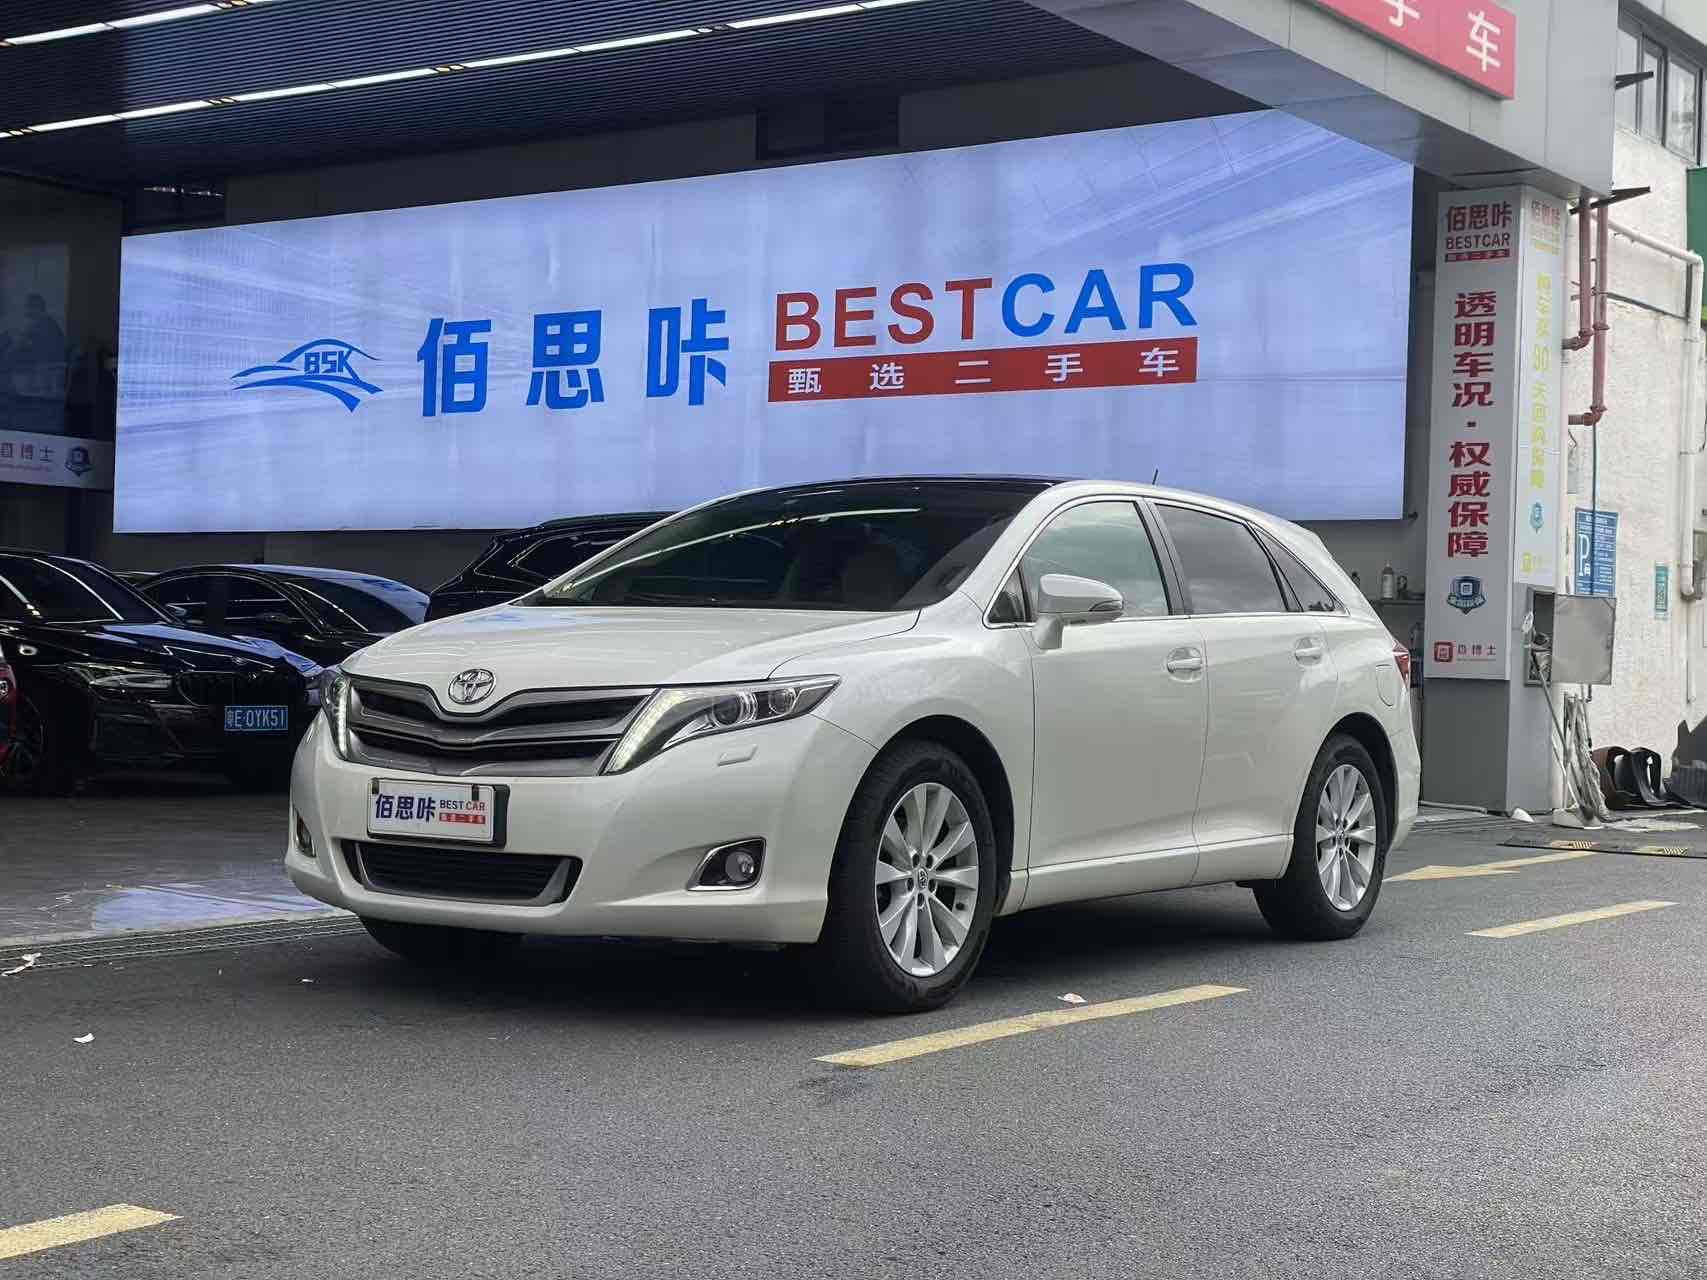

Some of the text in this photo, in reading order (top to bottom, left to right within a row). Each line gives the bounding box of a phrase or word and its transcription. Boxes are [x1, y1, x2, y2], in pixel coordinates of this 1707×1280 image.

[1446, 201, 1512, 232] 佰思咔
[1446, 232, 1510, 250] BESTCAR
[304, 350, 353, 376] BSK
[416, 298, 730, 417] 佰思咔
[788, 347, 1180, 395] 甄选二手车
[375, 793, 436, 823] 佰思咔
